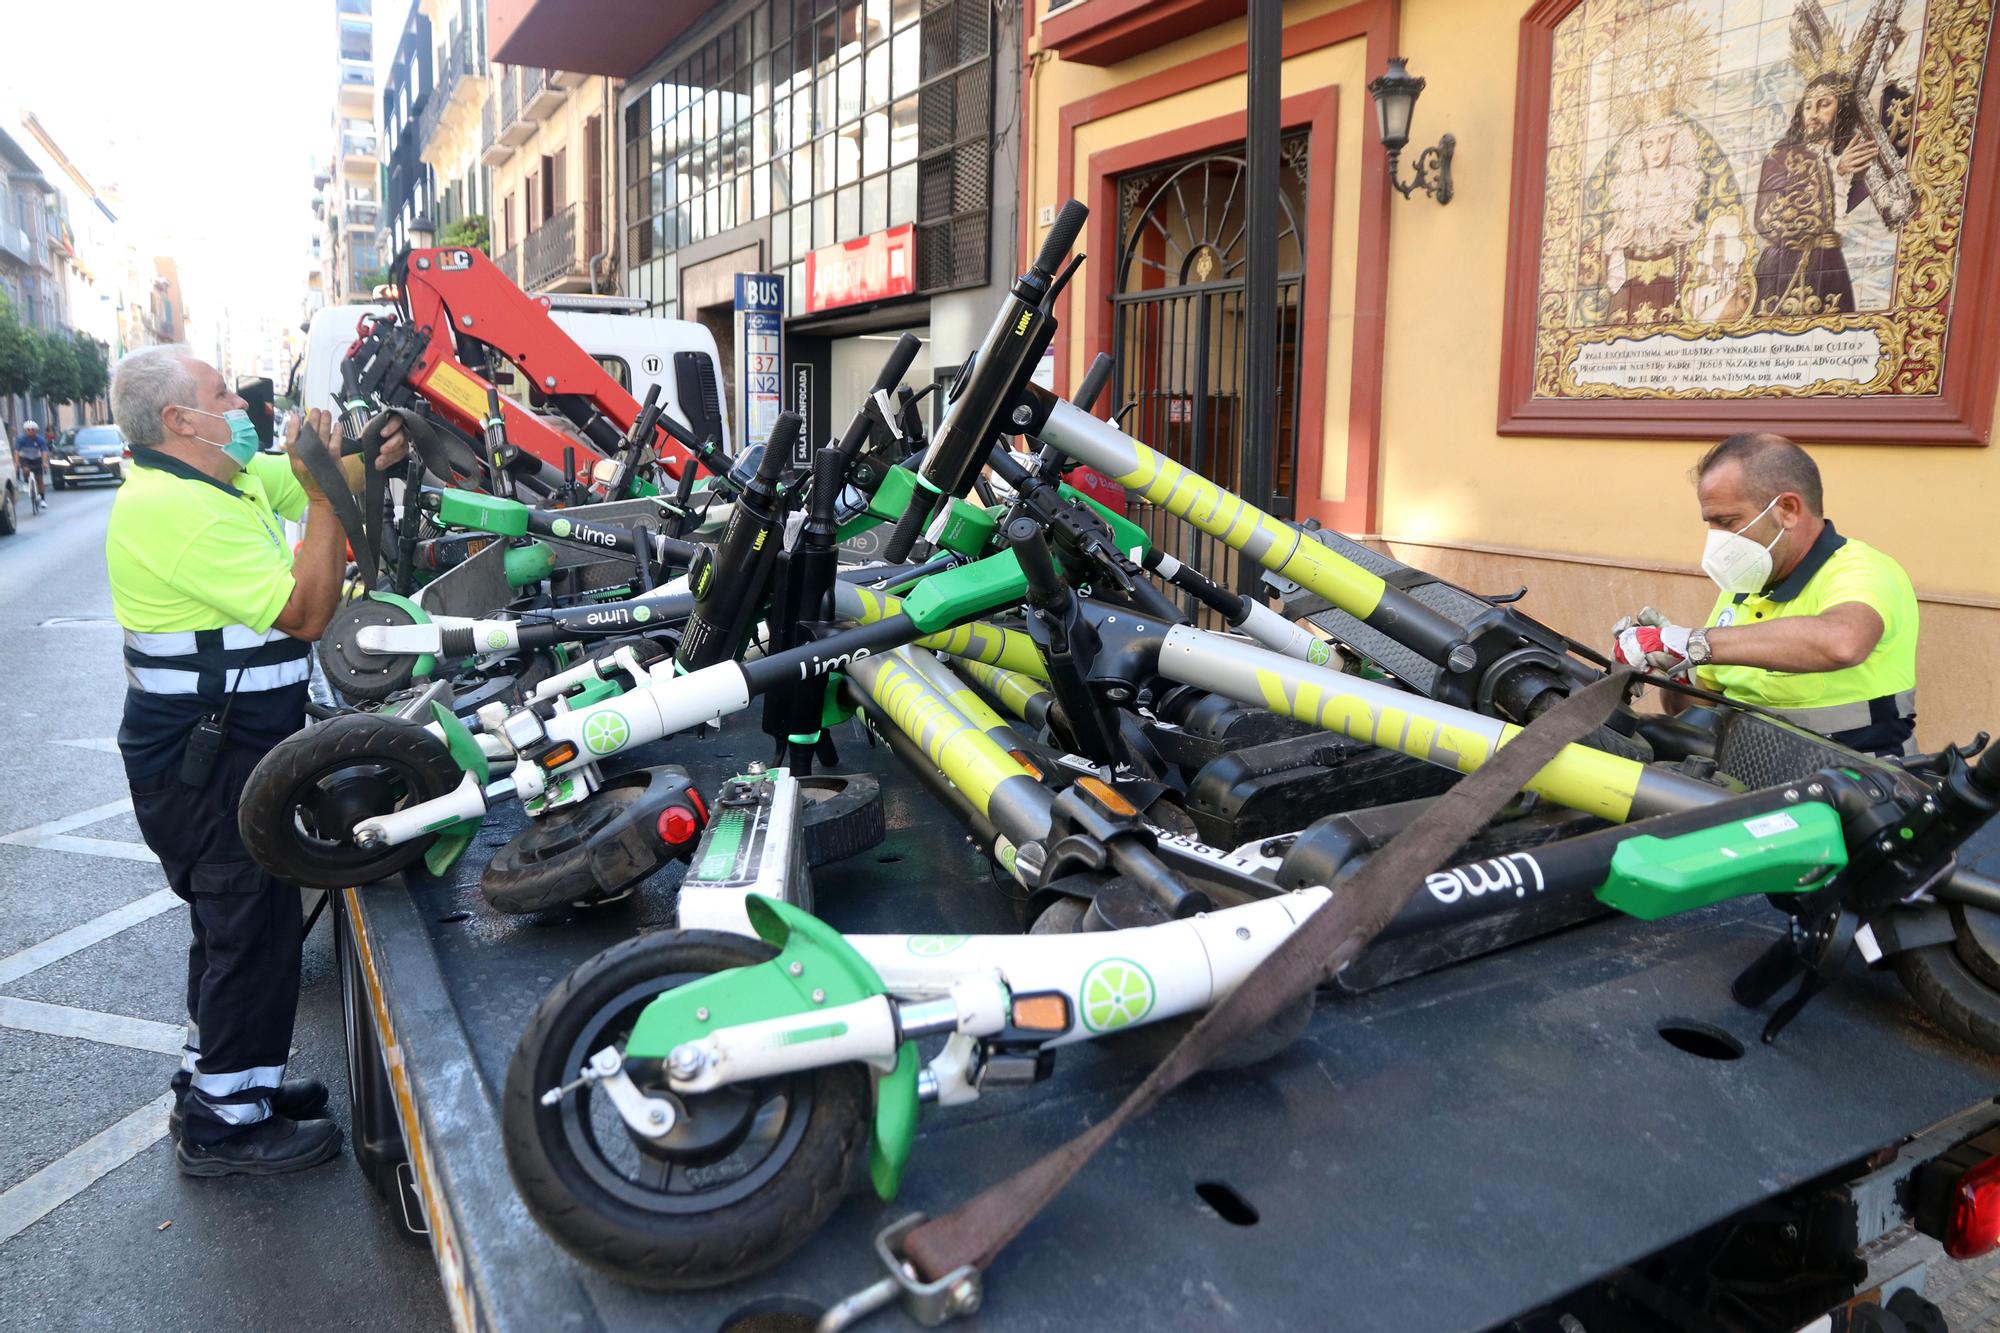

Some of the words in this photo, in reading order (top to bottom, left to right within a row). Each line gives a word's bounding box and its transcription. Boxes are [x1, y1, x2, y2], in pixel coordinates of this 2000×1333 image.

[440, 251, 469, 265] HC
[748, 281, 778, 306] BUS
[1015, 310, 1033, 336] LINK
[762, 336, 768, 352] 1
[1722, 345, 1766, 354] VENERABLE
[1814, 344, 1824, 352] DE
[1826, 341, 1855, 352] CULTO
[647, 359, 658, 371] 17
[754, 356, 774, 373] 37
[1668, 361, 1691, 369] PADRE
[1726, 359, 1771, 368] NAZARENO
[1775, 359, 1795, 368] BAJO
[754, 376, 776, 393] N2
[1776, 372, 1802, 380] AMOR
[799, 435, 807, 459] SALA
[575, 523, 617, 547] Lime
[752, 528, 769, 551] LINK
[586, 608, 629, 626] Lime
[1426, 851, 1545, 904] Lime
